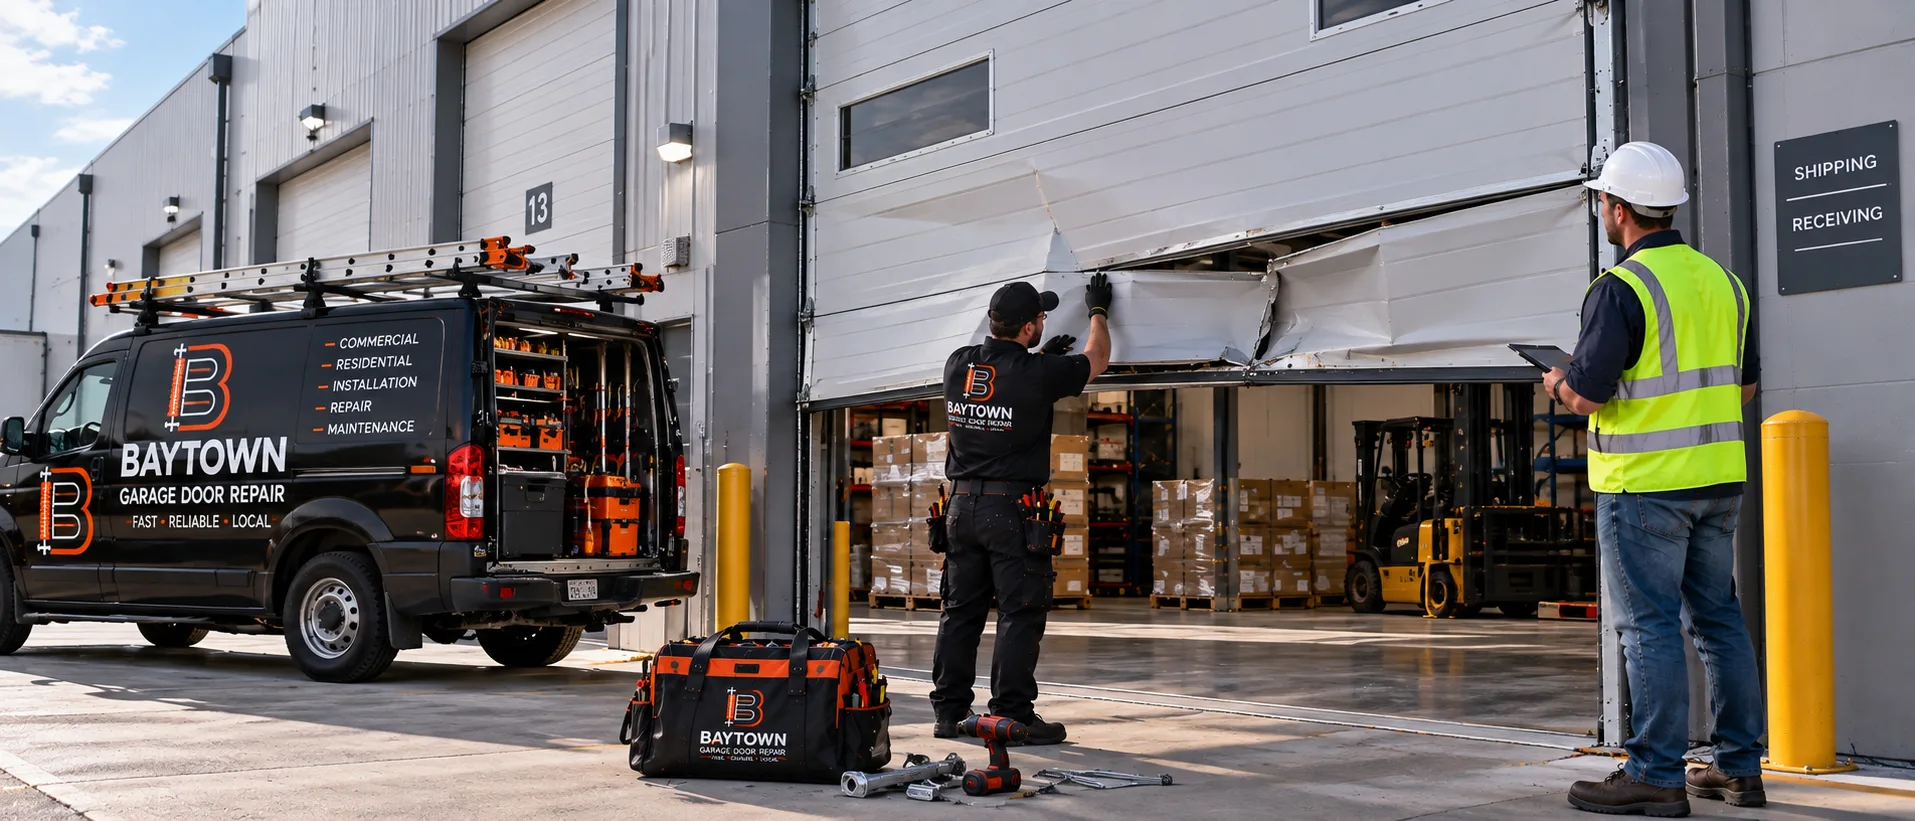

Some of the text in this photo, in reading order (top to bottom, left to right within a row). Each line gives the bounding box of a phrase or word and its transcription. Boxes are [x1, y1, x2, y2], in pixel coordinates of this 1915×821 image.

[1794, 154, 1877, 181] SHIPPING
[528, 192, 548, 226] 13
[1792, 206, 1883, 232] RECEIVING
[339, 333, 419, 349] COMMERCIAL
[336, 354, 413, 371] RESIDENTIAL
[165, 343, 233, 432] B
[333, 376, 418, 392] INSTALLATION
[330, 400, 372, 414] REPAIR
[947, 400, 1013, 420] BAYTOWN
[327, 420, 415, 435] MAINTENANCE
[120, 436, 288, 477] BAYTOWN
[119, 484, 285, 505] GARAGE DOOR REPAIR
[37, 466, 94, 556] B
[132, 514, 271, 529] FAST RELIABLE LOCAL
[699, 730, 787, 747] BAYTOWN
[699, 746, 731, 755] GARAGE
[733, 747, 757, 755] DOOR
